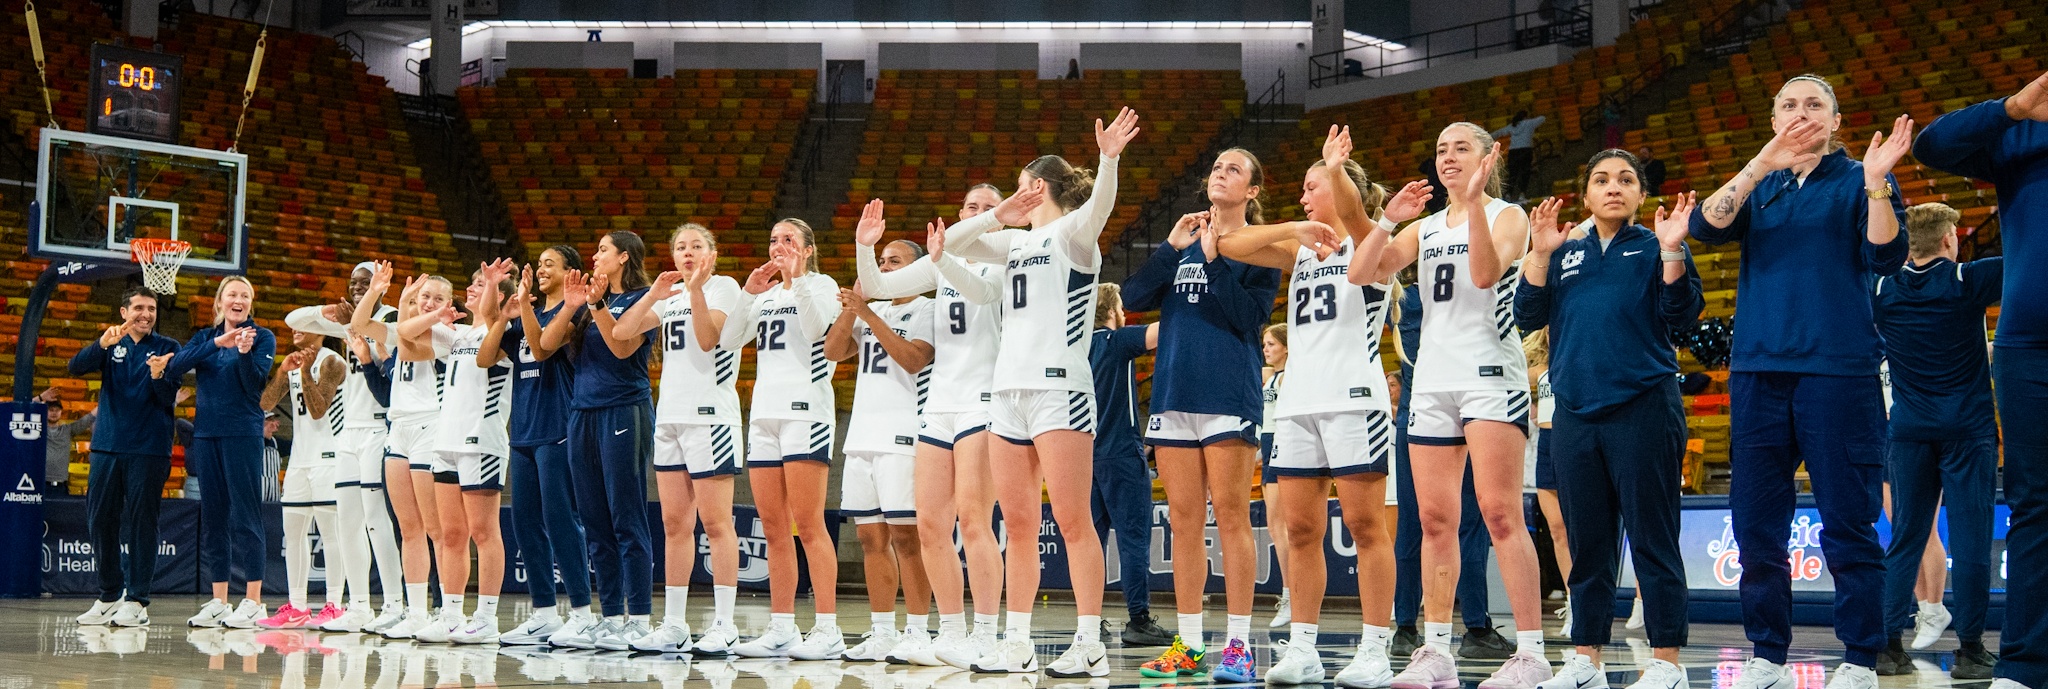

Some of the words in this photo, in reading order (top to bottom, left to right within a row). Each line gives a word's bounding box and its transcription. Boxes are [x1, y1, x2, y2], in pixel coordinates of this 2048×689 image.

[447, 4, 458, 18] H
[1317, 4, 1326, 17] H
[1022, 255, 1050, 268] STATE
[1447, 244, 1468, 255] STA
[1314, 265, 1348, 279] STATE
[1434, 263, 1455, 303] 8
[1012, 273, 1027, 310] 0
[949, 301, 966, 334] 9
[1296, 284, 1337, 327] 23
[664, 320, 686, 352] 15
[757, 319, 786, 351] 32
[863, 342, 888, 373] 12
[450, 360, 459, 386] 1
[297, 392, 307, 416] 3
[9, 421, 42, 432] STATE
[3, 492, 43, 502] Altabank
[59, 557, 98, 572] Heal
[1713, 548, 1823, 586] Cle
